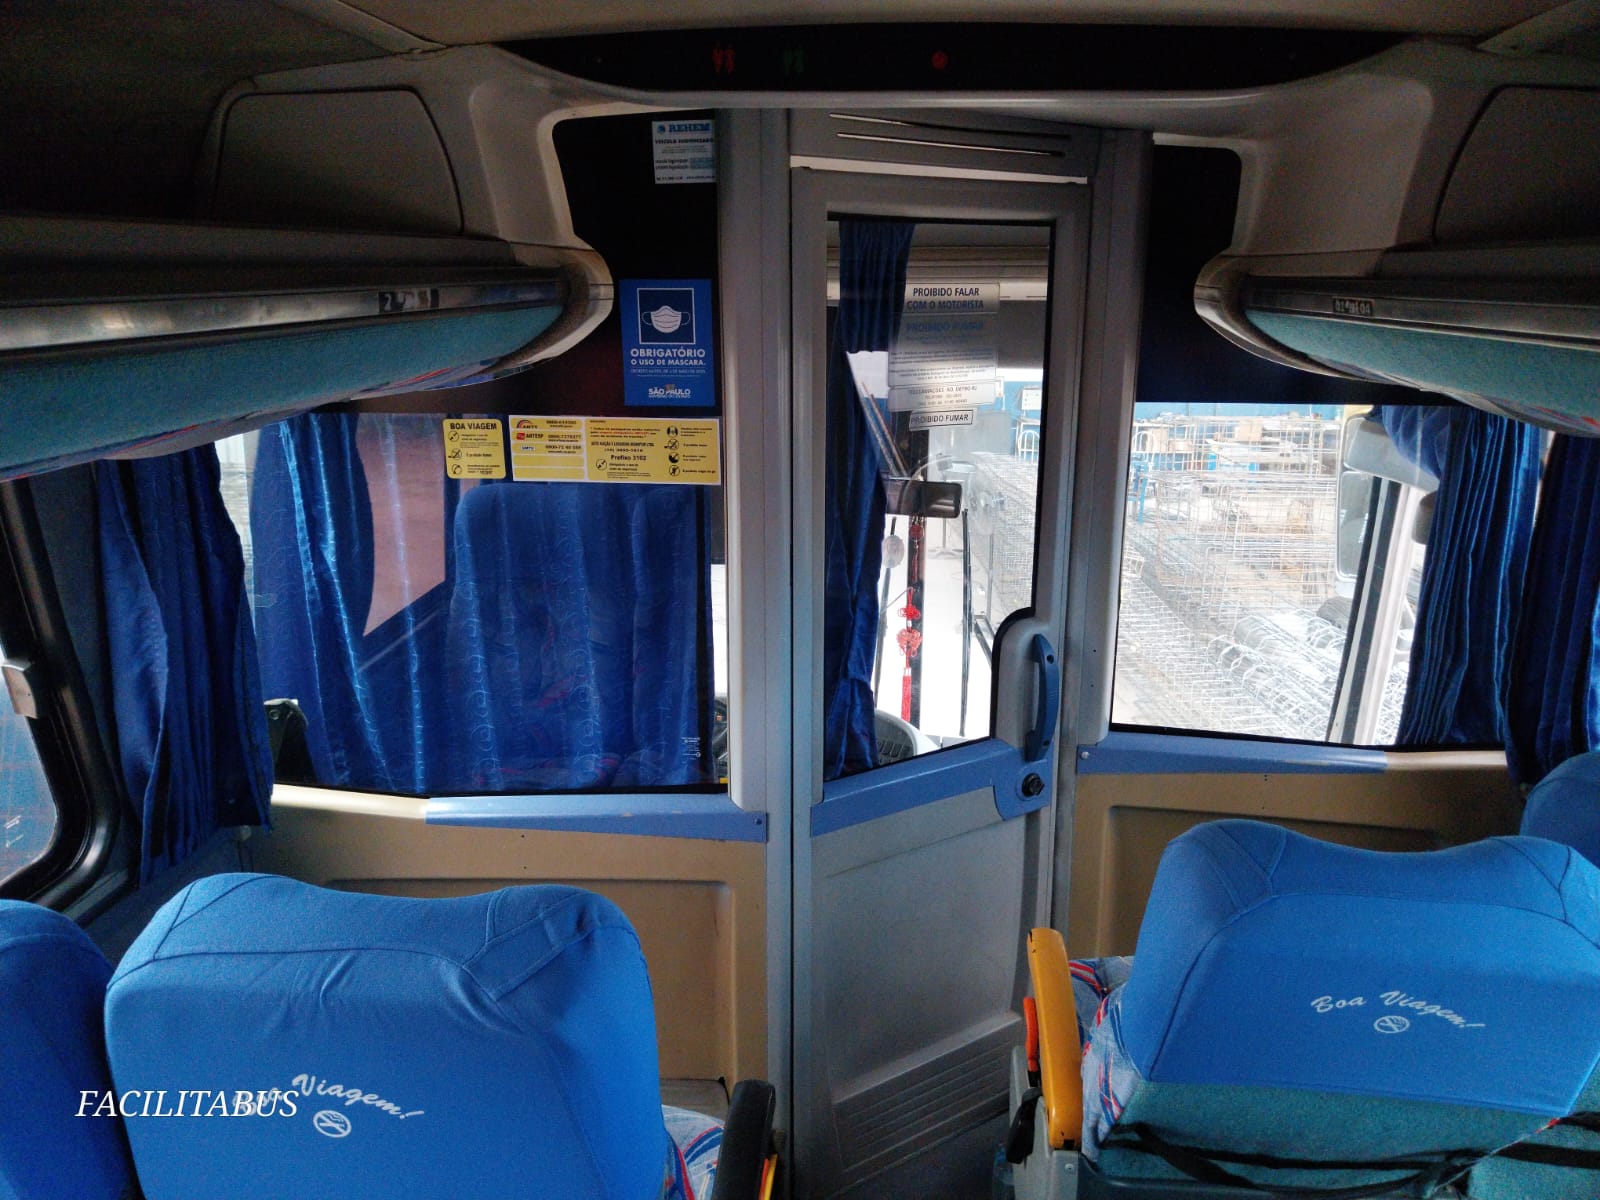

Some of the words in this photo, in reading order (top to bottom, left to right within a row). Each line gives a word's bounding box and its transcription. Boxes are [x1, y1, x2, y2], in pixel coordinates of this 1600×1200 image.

[912, 287, 953, 297] PROIBIDO
[954, 287, 980, 297] FALAR
[906, 300, 928, 310] COM
[929, 300, 936, 309] O
[938, 300, 985, 309] MOTORISTA
[630, 346, 706, 358] OBRIGATÓRIO
[648, 386, 665, 395] SÃO
[910, 415, 944, 424] PROIBIDO
[945, 413, 969, 422] FUMAR
[467, 422, 497, 430] VIAGEM
[1310, 995, 1367, 1013] Boa
[1379, 990, 1486, 1028] Viagem!
[291, 1073, 425, 1119] Viagem!
